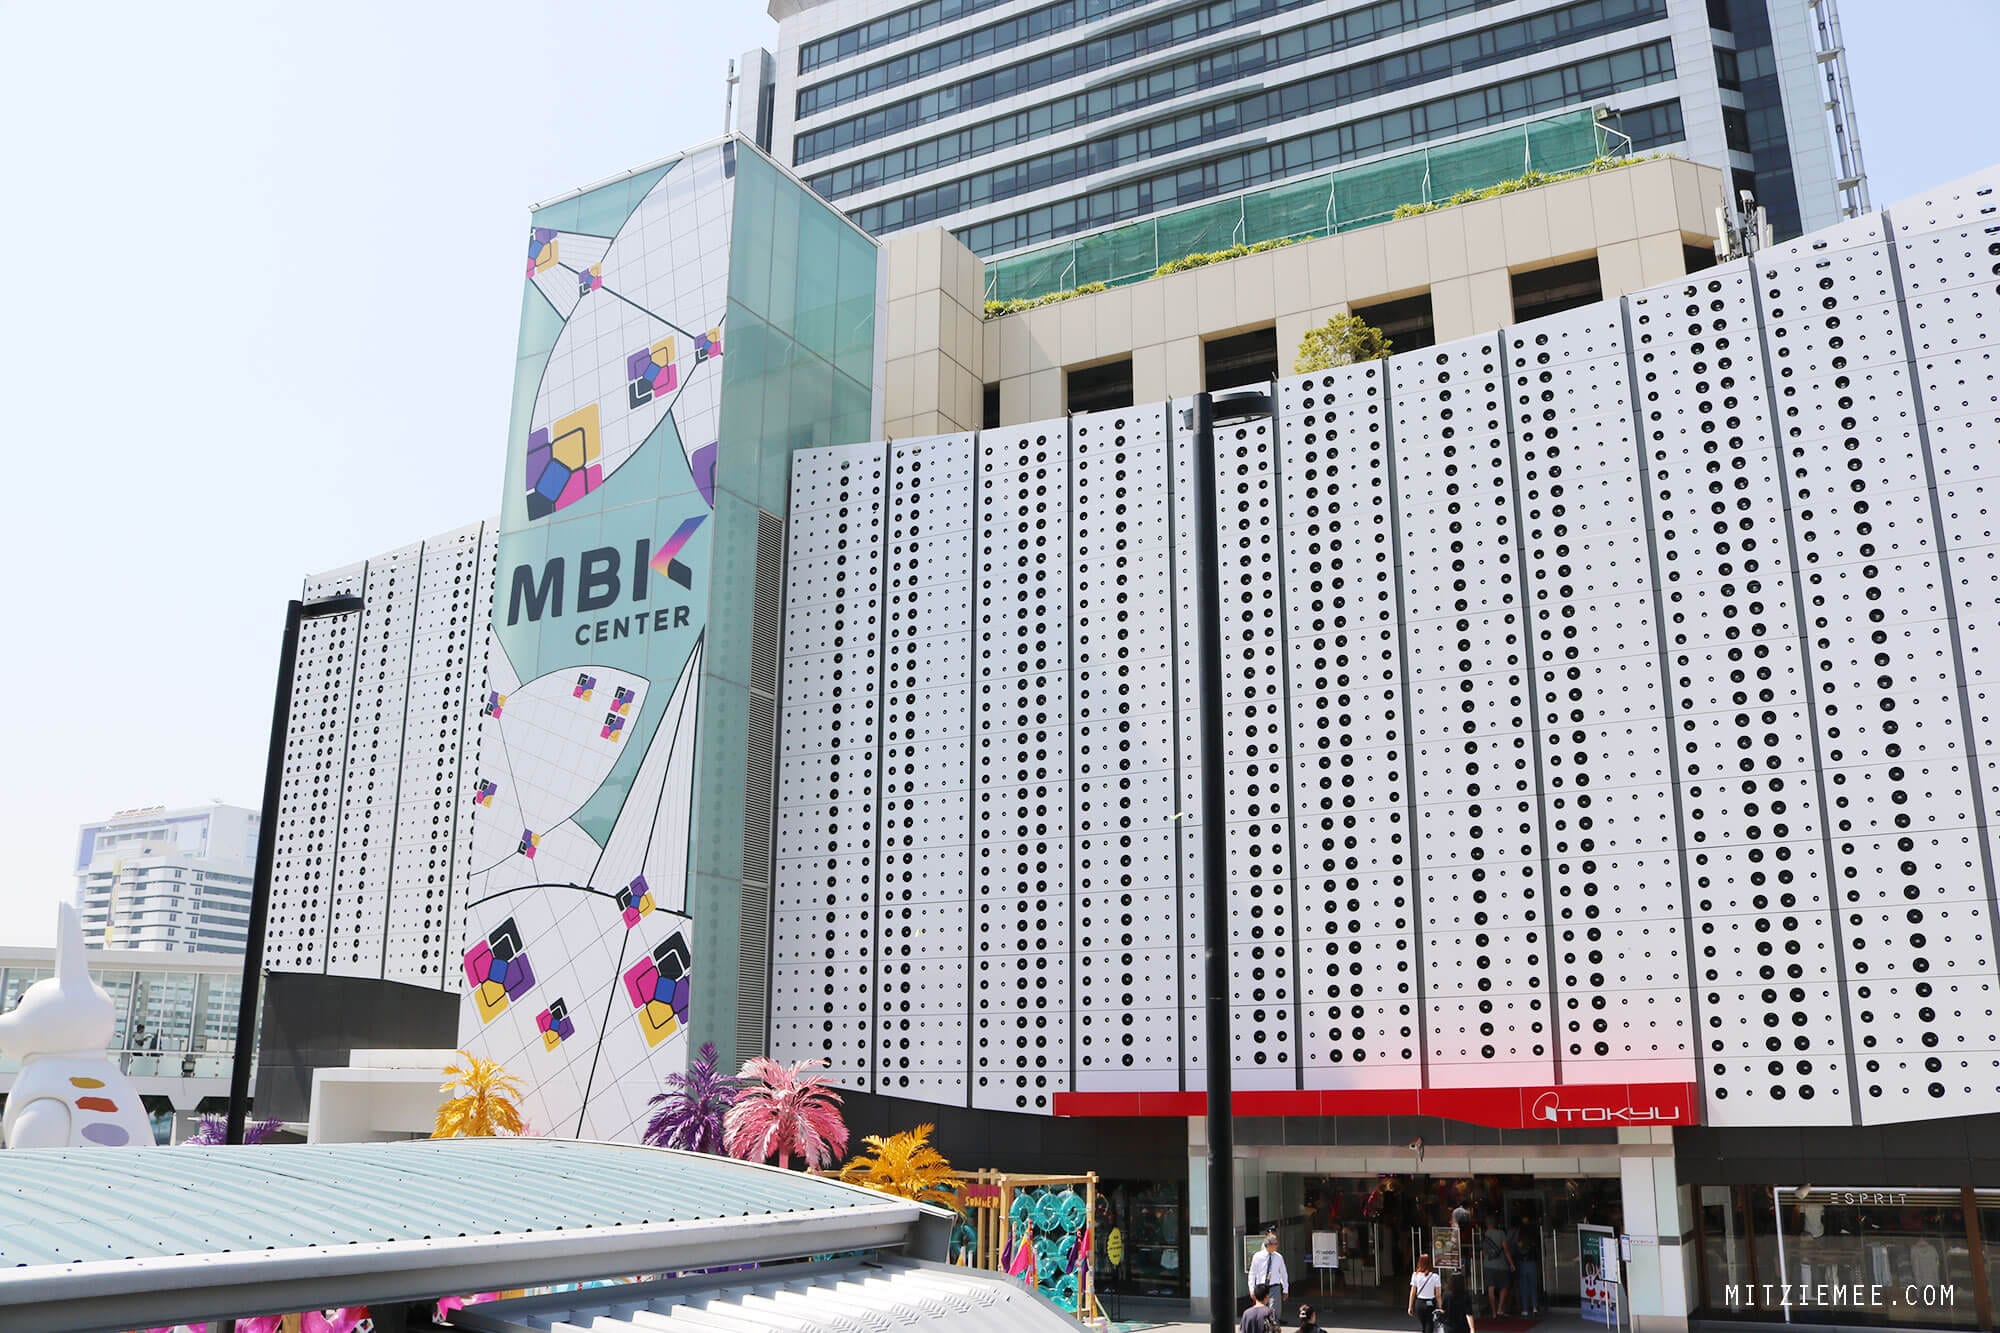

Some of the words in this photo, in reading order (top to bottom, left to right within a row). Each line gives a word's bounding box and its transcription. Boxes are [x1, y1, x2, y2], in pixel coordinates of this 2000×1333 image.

[507, 514, 708, 626] MBK
[575, 605, 690, 646] CENTER
[1557, 1106, 1680, 1122] TOKYU
[1830, 1192, 1907, 1205] ESPRIT
